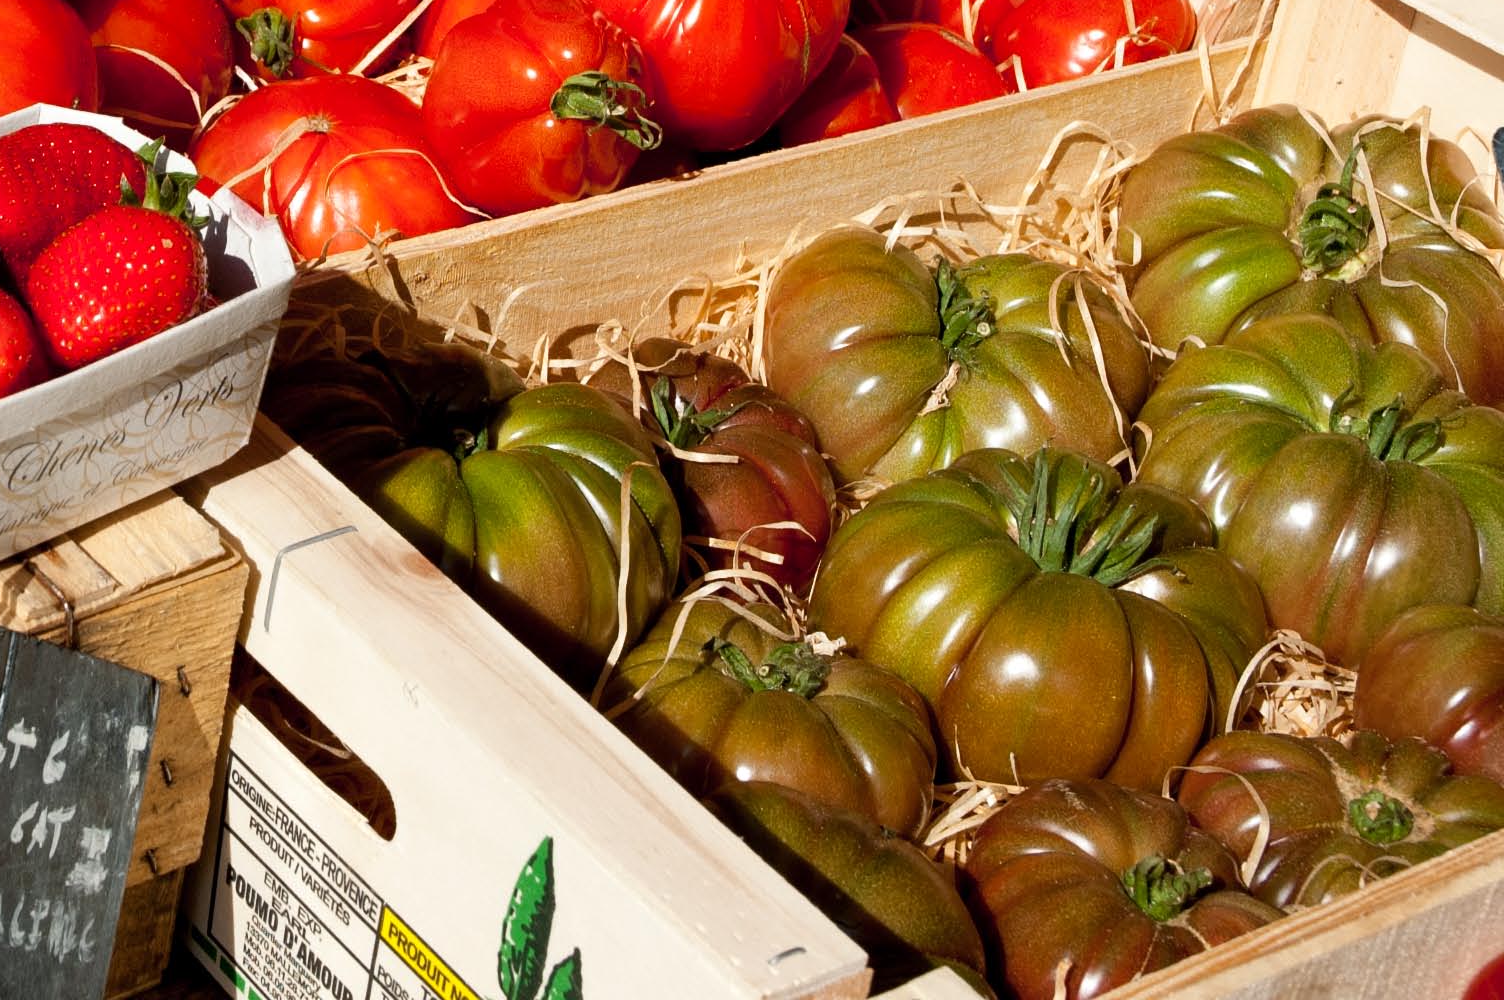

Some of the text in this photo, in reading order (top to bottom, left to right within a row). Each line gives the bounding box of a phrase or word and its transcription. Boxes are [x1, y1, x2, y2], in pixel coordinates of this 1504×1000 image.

[249, 816, 295, 870] PRODUIT
[226, 864, 279, 932] POUMO
[272, 896, 311, 946] EARL
[321, 853, 379, 923] PROVENCE
[388, 922, 451, 992] PRODUIT
